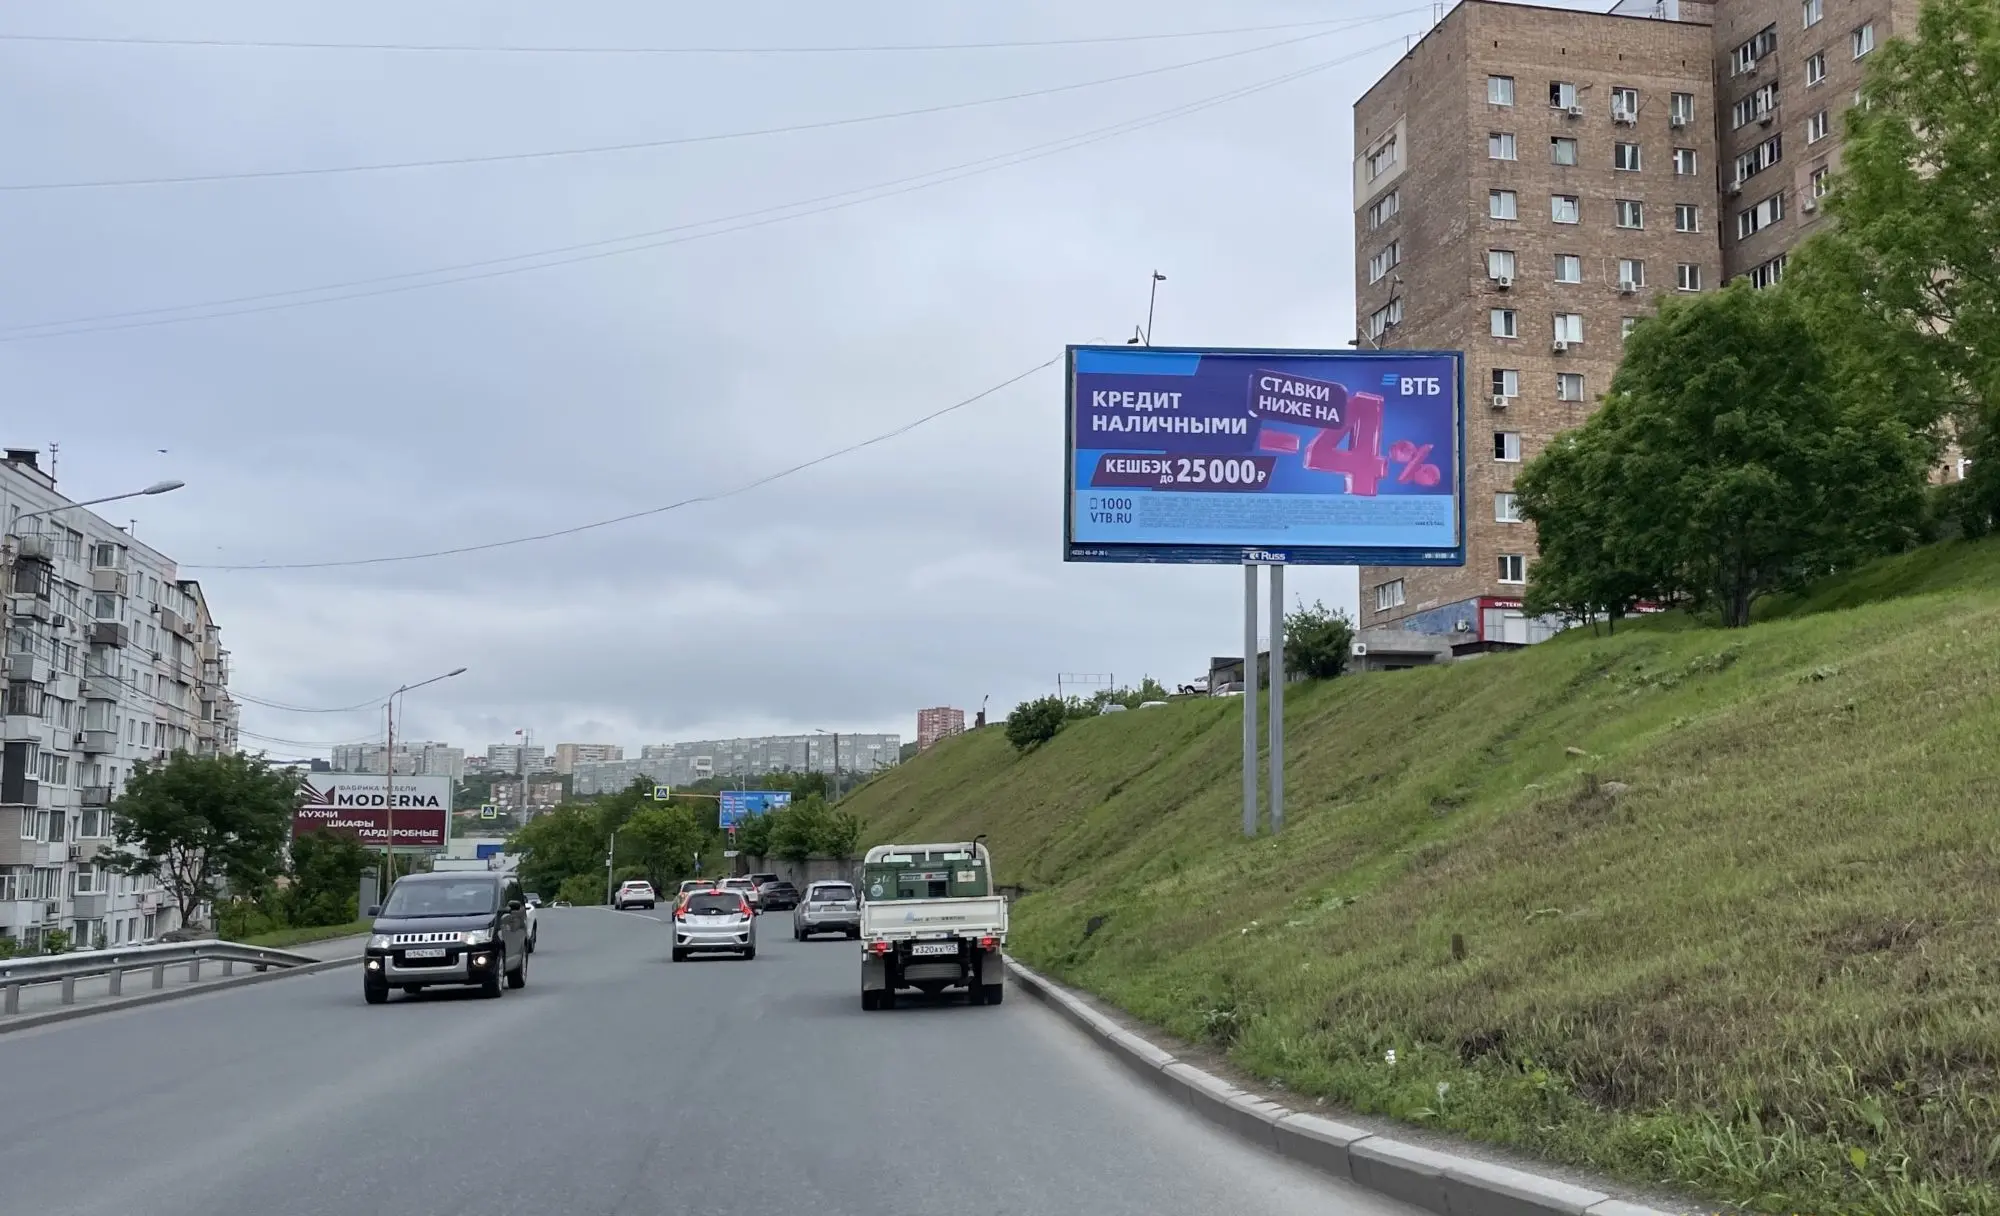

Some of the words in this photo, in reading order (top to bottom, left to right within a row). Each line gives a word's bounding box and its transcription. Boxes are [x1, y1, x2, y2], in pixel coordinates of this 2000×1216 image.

[1260, 376, 1330, 402] СТАВКИ
[1401, 377, 1441, 396] ВТБ
[1092, 390, 1182, 412] КРЕДИТ
[1259, 395, 1312, 418] НИЖЕ
[1315, 407, 1341, 423] НА
[1092, 415, 1247, 435] НАЛИЧНЫМИ
[1105, 459, 1172, 474] КЕШБЭК
[1101, 498, 1132, 510] 1000
[1090, 512, 1132, 525] VTB.RU
[1261, 551, 1286, 561] Russ
[338, 794, 440, 807] MODERNA
[298, 810, 338, 819] КУХНИ
[326, 820, 375, 828] ШКАФЫ
